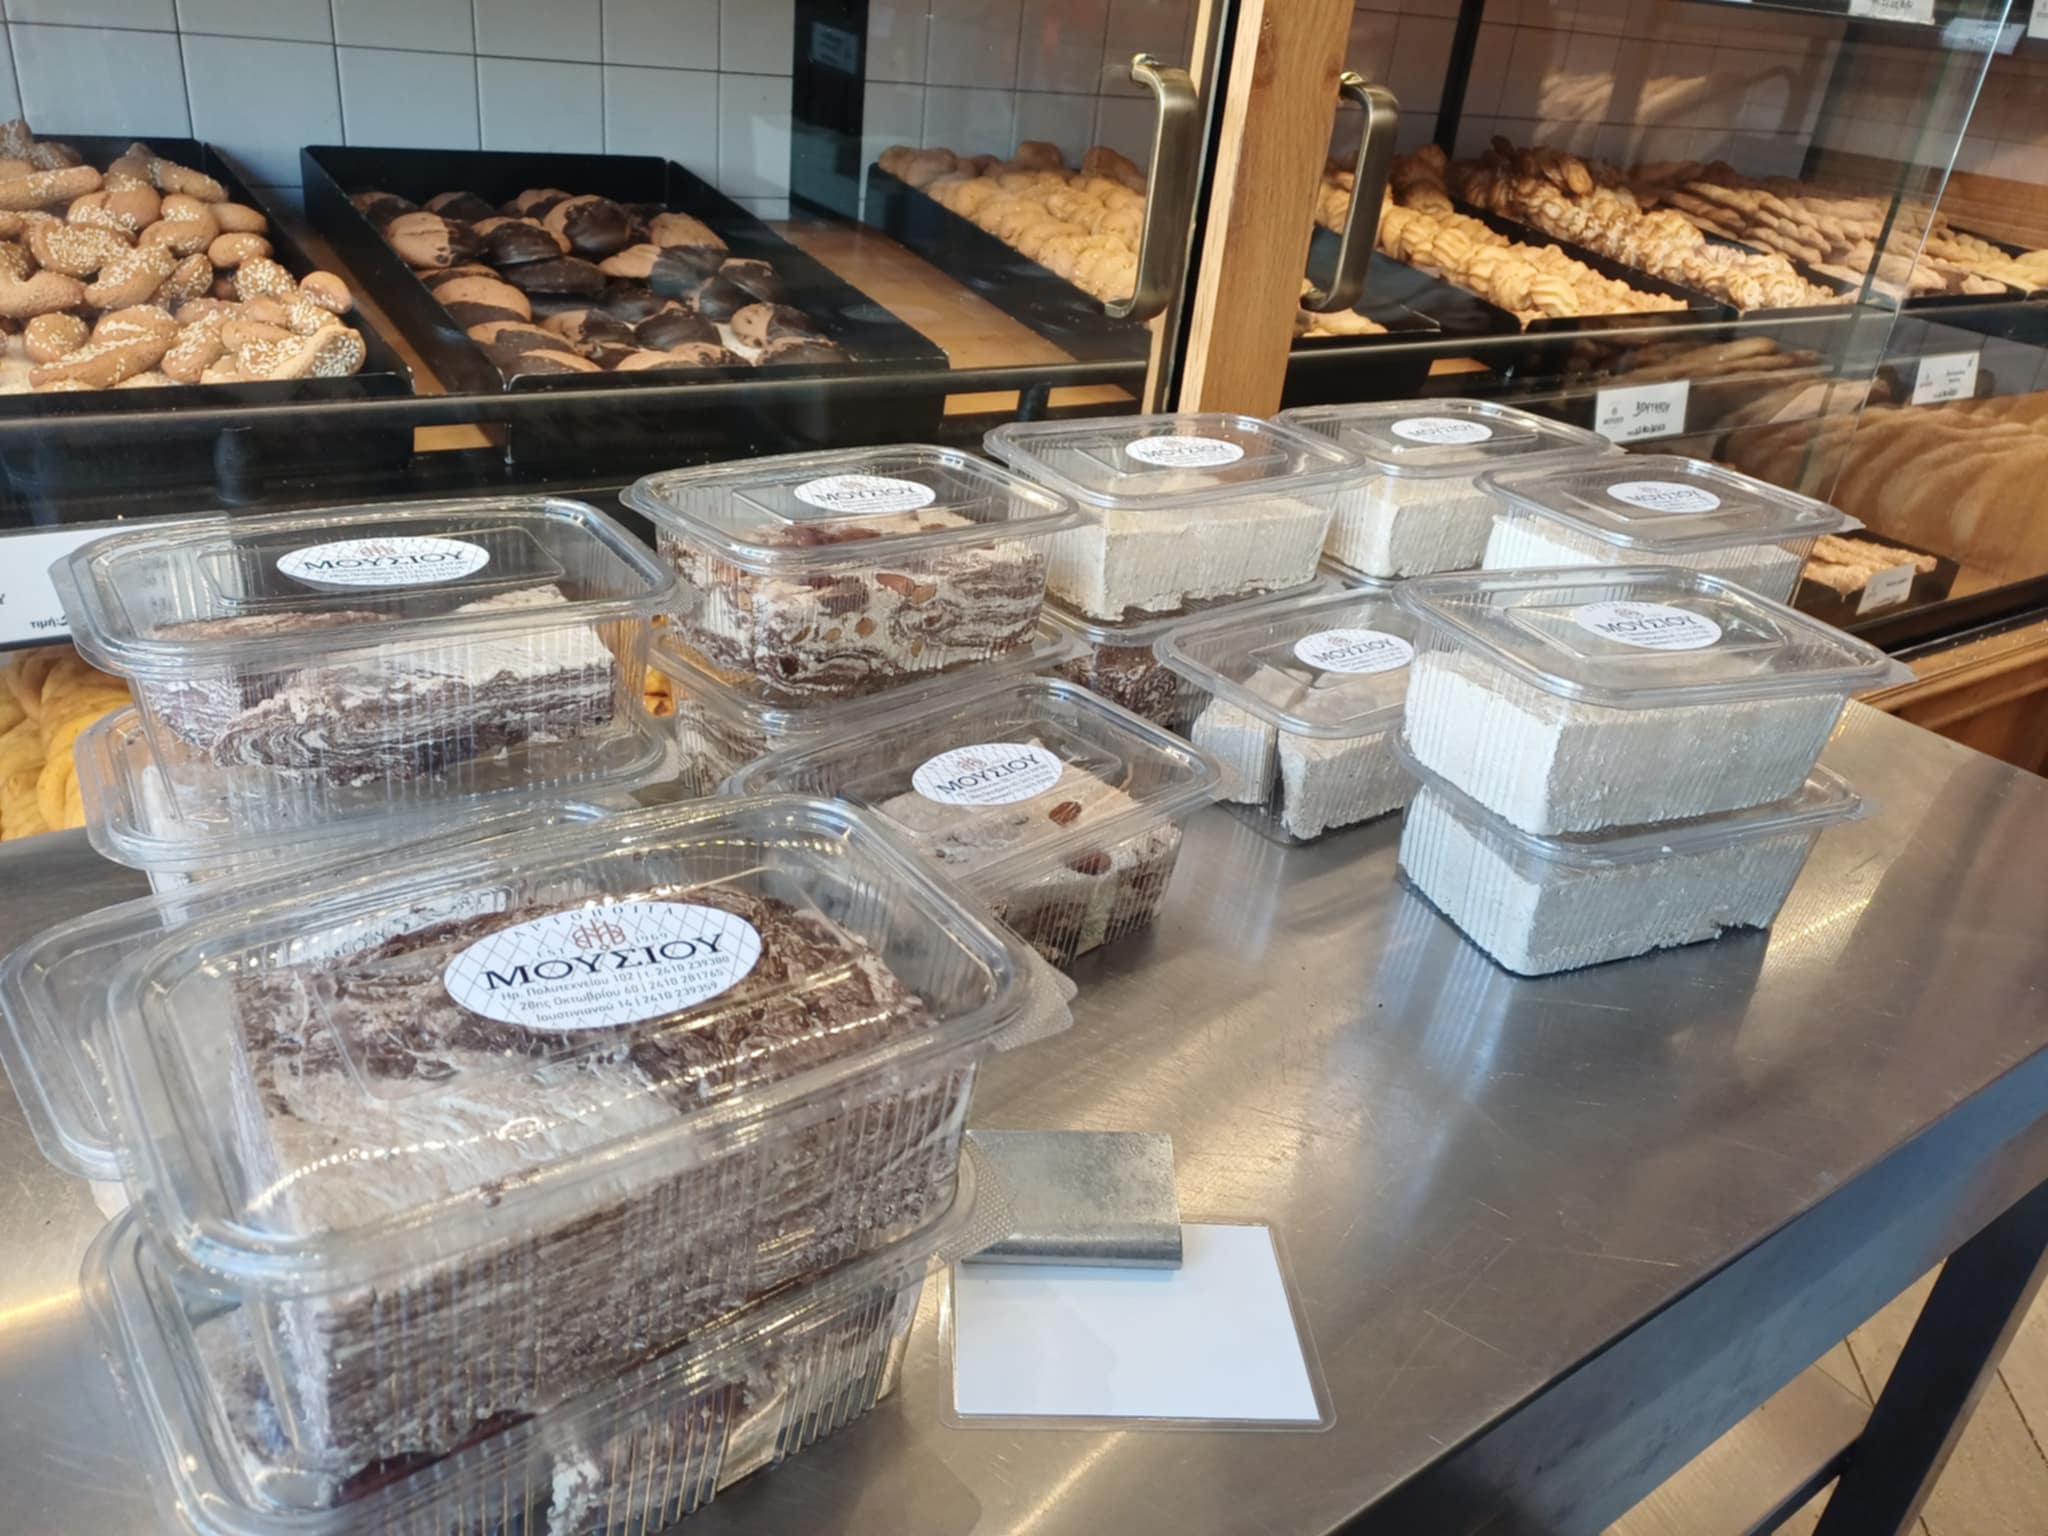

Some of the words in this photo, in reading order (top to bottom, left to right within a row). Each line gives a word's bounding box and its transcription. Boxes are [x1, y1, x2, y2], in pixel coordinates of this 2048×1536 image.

[304, 550, 464, 571] ΜΟΥΣΙΟΥ
[936, 753, 1041, 794] ΜΟΥΣΙΟΥ
[484, 933, 724, 991] ΜΟΥΣΙΟΥ
